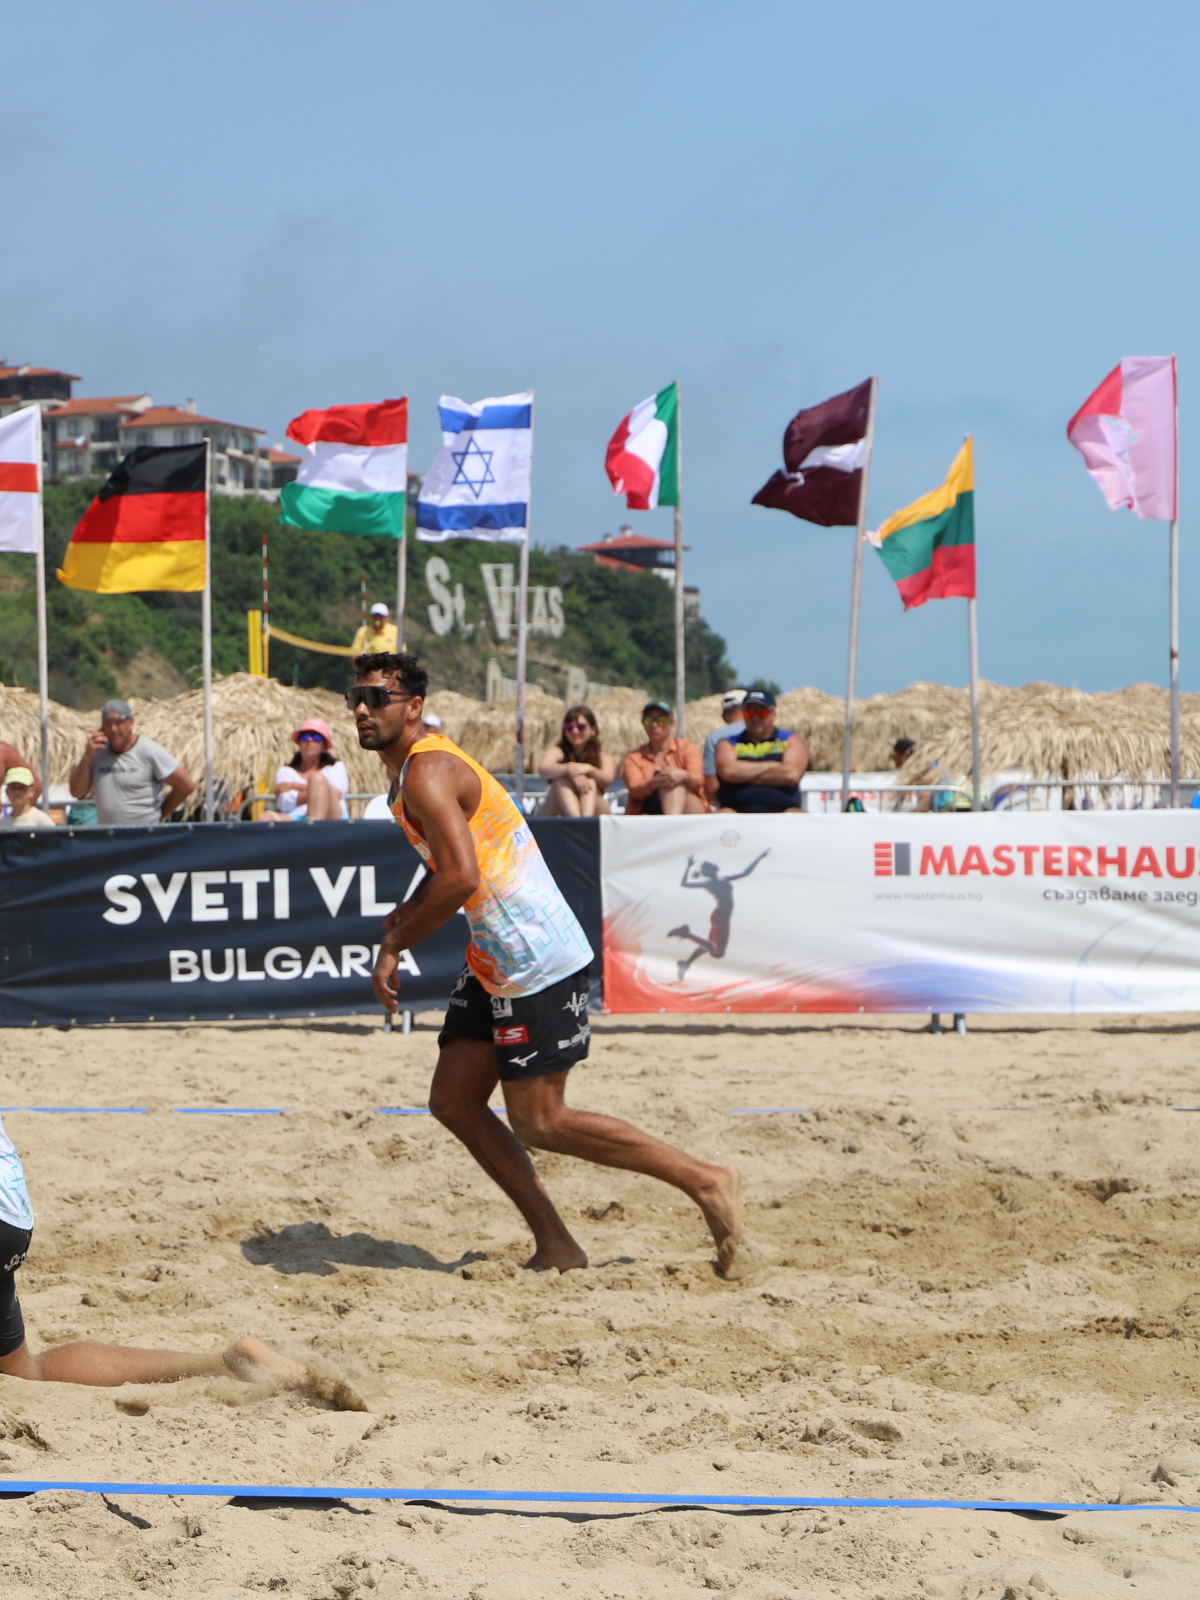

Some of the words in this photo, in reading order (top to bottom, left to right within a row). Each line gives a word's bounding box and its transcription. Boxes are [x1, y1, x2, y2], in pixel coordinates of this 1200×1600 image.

[918, 844, 1200, 878] MASTERHAU
[102, 868, 291, 925] SVETI
[874, 891, 983, 902] www.masterhaus.bg
[1153, 889, 1200, 908] заед
